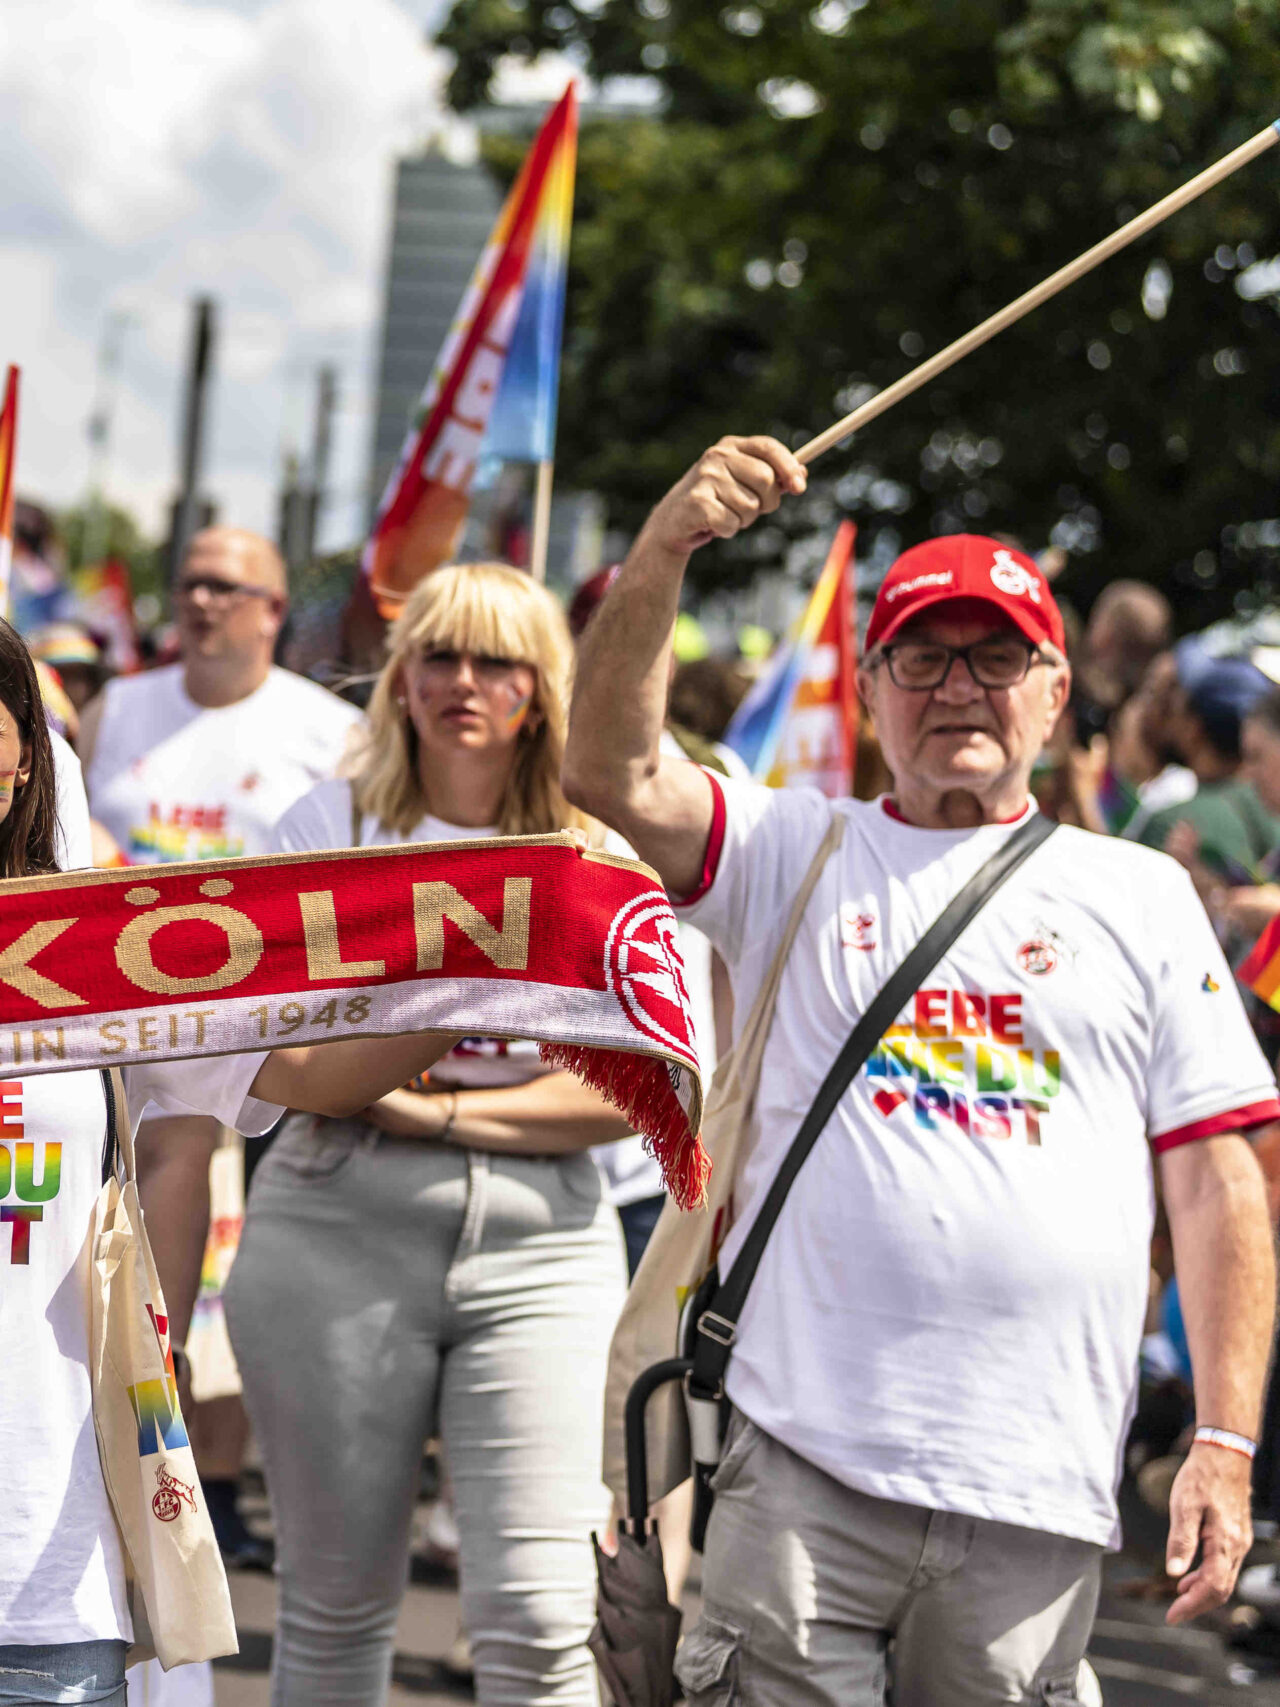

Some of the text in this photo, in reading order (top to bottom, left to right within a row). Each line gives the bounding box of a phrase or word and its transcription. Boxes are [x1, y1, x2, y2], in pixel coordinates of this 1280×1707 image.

[98, 1010, 216, 1056] SEIT
[248, 995, 372, 1038] 1948
[975, 1043, 1061, 1098] DU
[913, 1086, 1051, 1147] BIST
